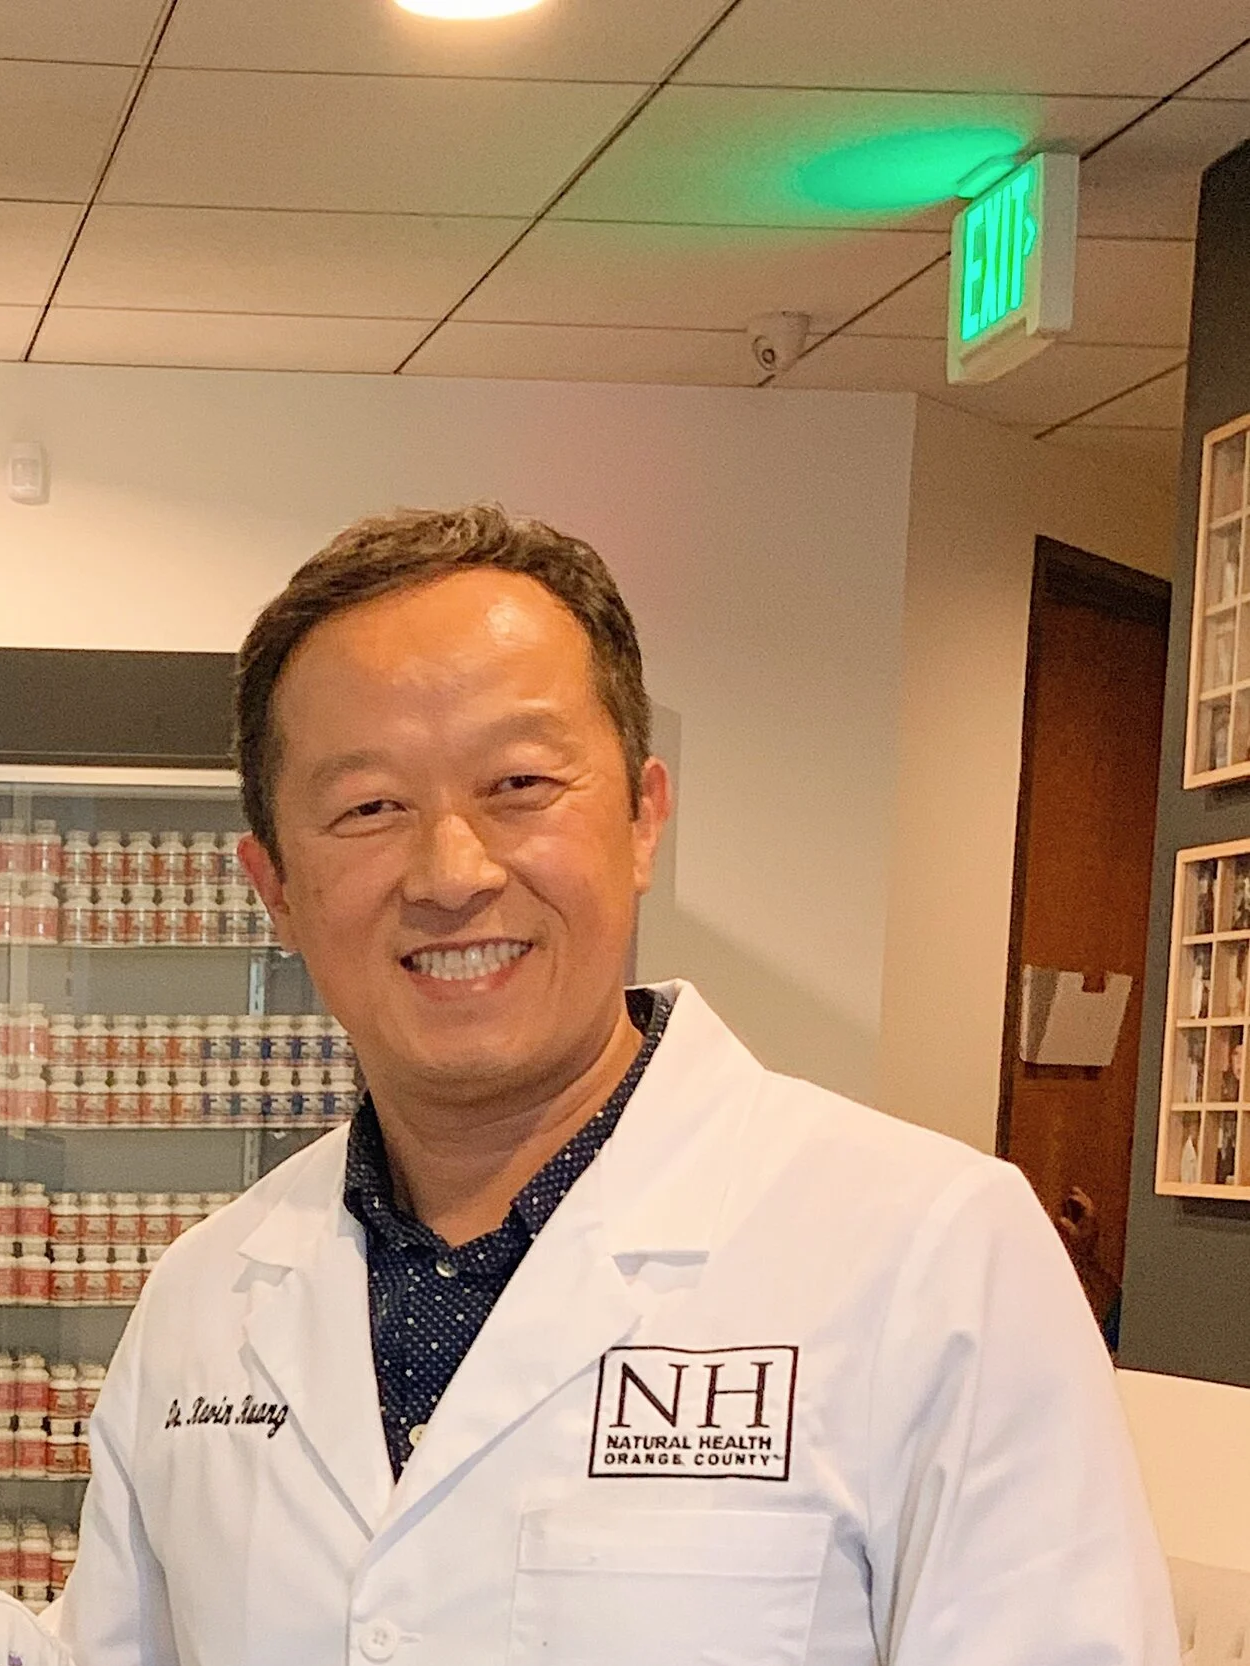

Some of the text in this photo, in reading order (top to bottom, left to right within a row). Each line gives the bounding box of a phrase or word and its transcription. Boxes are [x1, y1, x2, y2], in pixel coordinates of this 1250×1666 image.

[961, 172, 1030, 340] EXIT
[609, 1361, 774, 1429] NH
[604, 1453, 770, 1466] ORANGE COUNTY
[606, 1435, 772, 1450] NATURAL HEALTH
